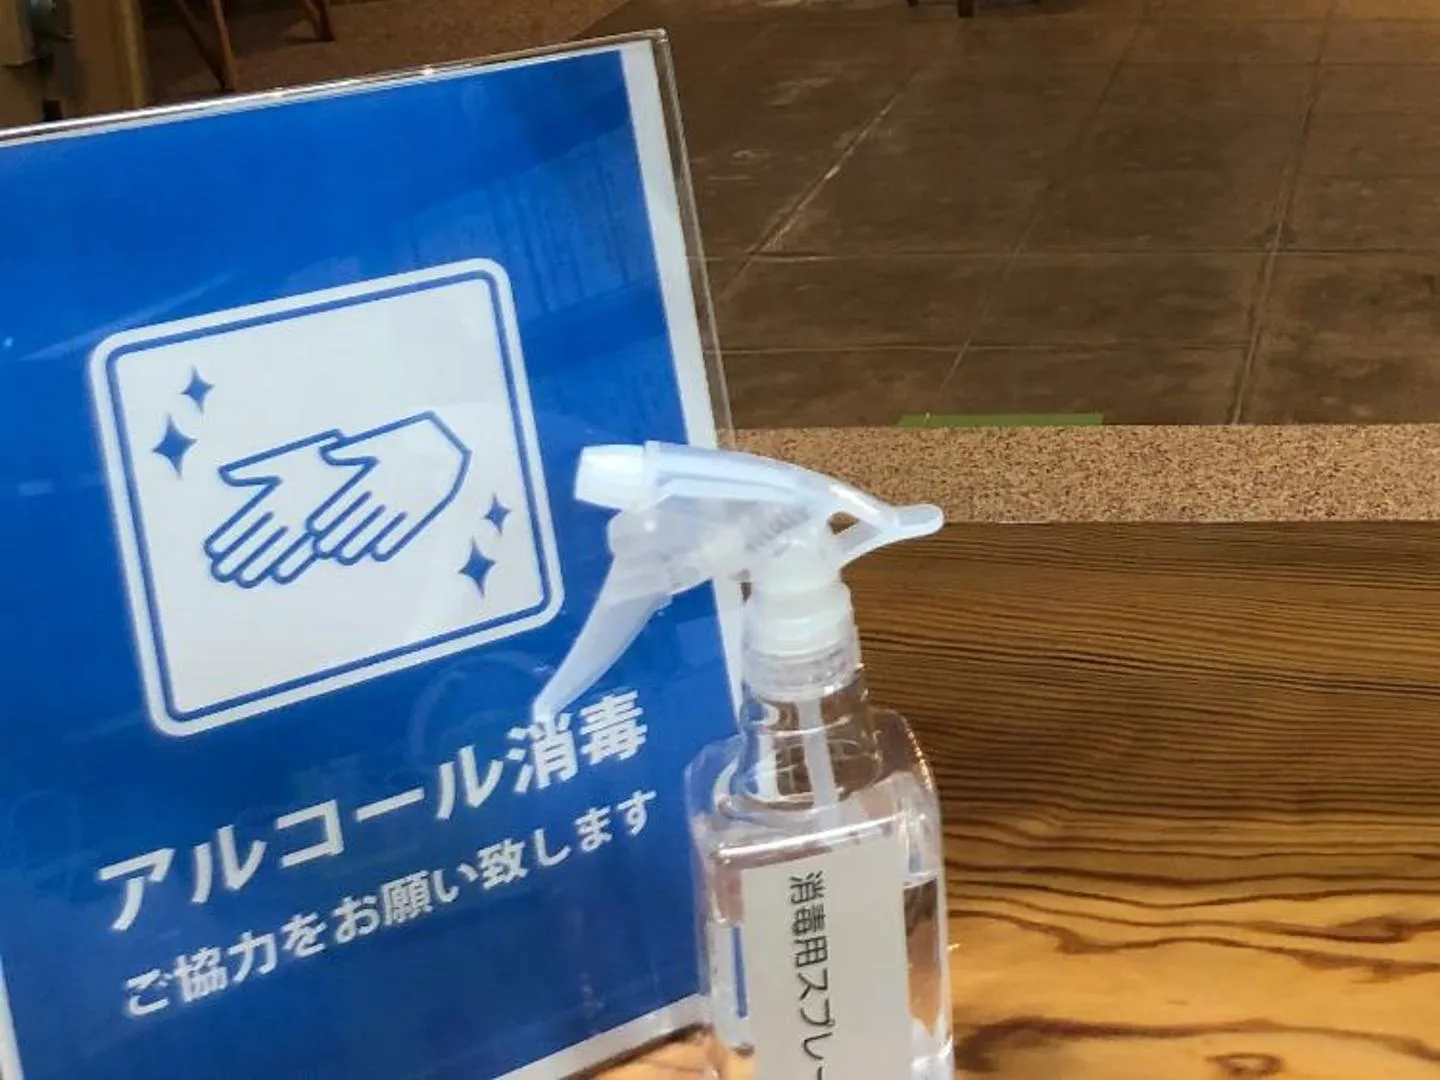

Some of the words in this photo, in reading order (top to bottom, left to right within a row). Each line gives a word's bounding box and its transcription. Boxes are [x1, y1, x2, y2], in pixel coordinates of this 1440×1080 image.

[98, 688, 649, 933] アルコール消毒
[124, 789, 657, 1018] ご協力をお願い致します
